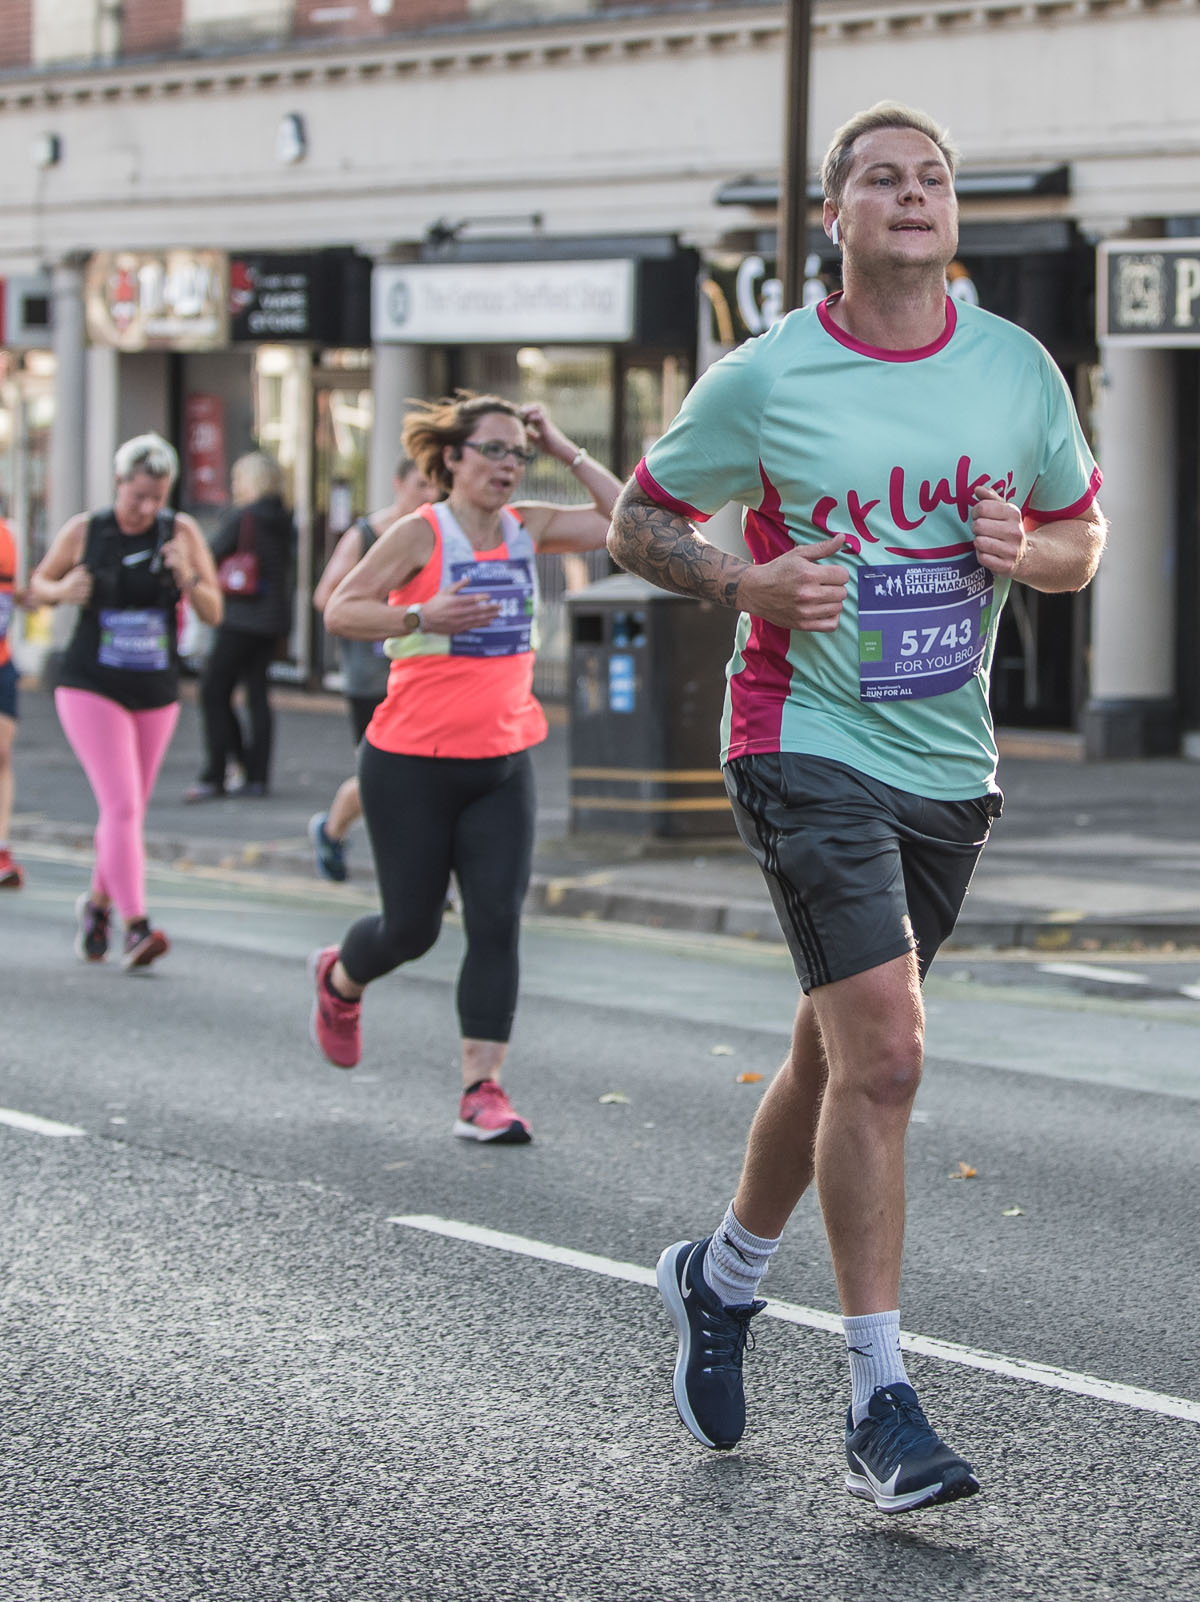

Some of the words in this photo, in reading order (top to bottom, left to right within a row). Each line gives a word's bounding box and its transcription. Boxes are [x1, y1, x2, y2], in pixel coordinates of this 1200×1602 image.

[736, 253, 827, 336] Caé
[906, 571, 958, 584] SHEFFIELD
[906, 584, 935, 595] HALF
[936, 568, 985, 593] MARATHON
[967, 580, 985, 596] 2020
[900, 618, 972, 657] 5743
[895, 660, 923, 673] FOR
[926, 656, 952, 669] YOU
[955, 646, 974, 664] BRO
[866, 690, 882, 698] RUN
[883, 689, 899, 697] FOR
[900, 687, 913, 696] ALL
